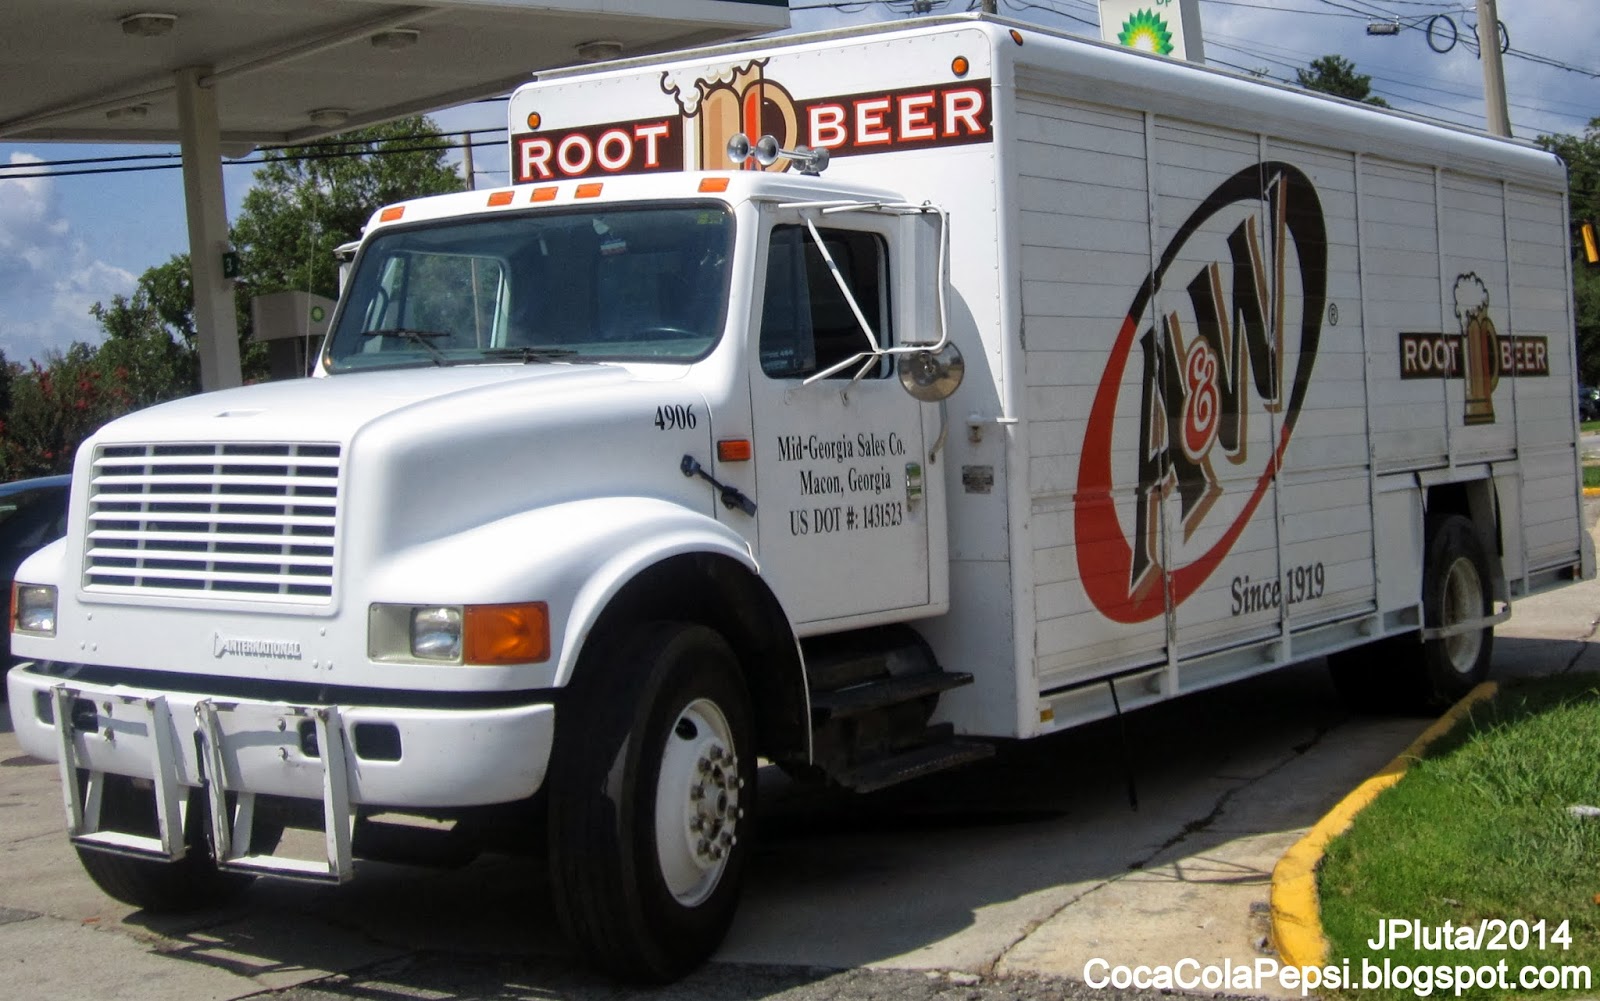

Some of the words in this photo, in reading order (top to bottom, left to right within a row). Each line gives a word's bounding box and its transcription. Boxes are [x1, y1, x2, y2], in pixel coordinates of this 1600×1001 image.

[519, 122, 670, 183] ROOT
[806, 88, 986, 150] BEER
[1404, 338, 1459, 372] ROOT
[1500, 339, 1547, 370] BEER
[1128, 171, 1288, 600] A&W
[654, 404, 697, 431] 4906
[777, 436, 854, 463] Mid-Georgia
[857, 433, 886, 456] Sales
[889, 432, 906, 456] Co.
[800, 471, 844, 496] Macon,
[848, 466, 891, 493] Georgia
[789, 510, 809, 536] US
[814, 507, 842, 532] DOT
[845, 506, 859, 530] #:
[863, 502, 903, 528] 1431523
[1231, 576, 1282, 616] Since
[1285, 562, 1326, 604] 1919
[228, 639, 302, 660] INTERNATIONAL
